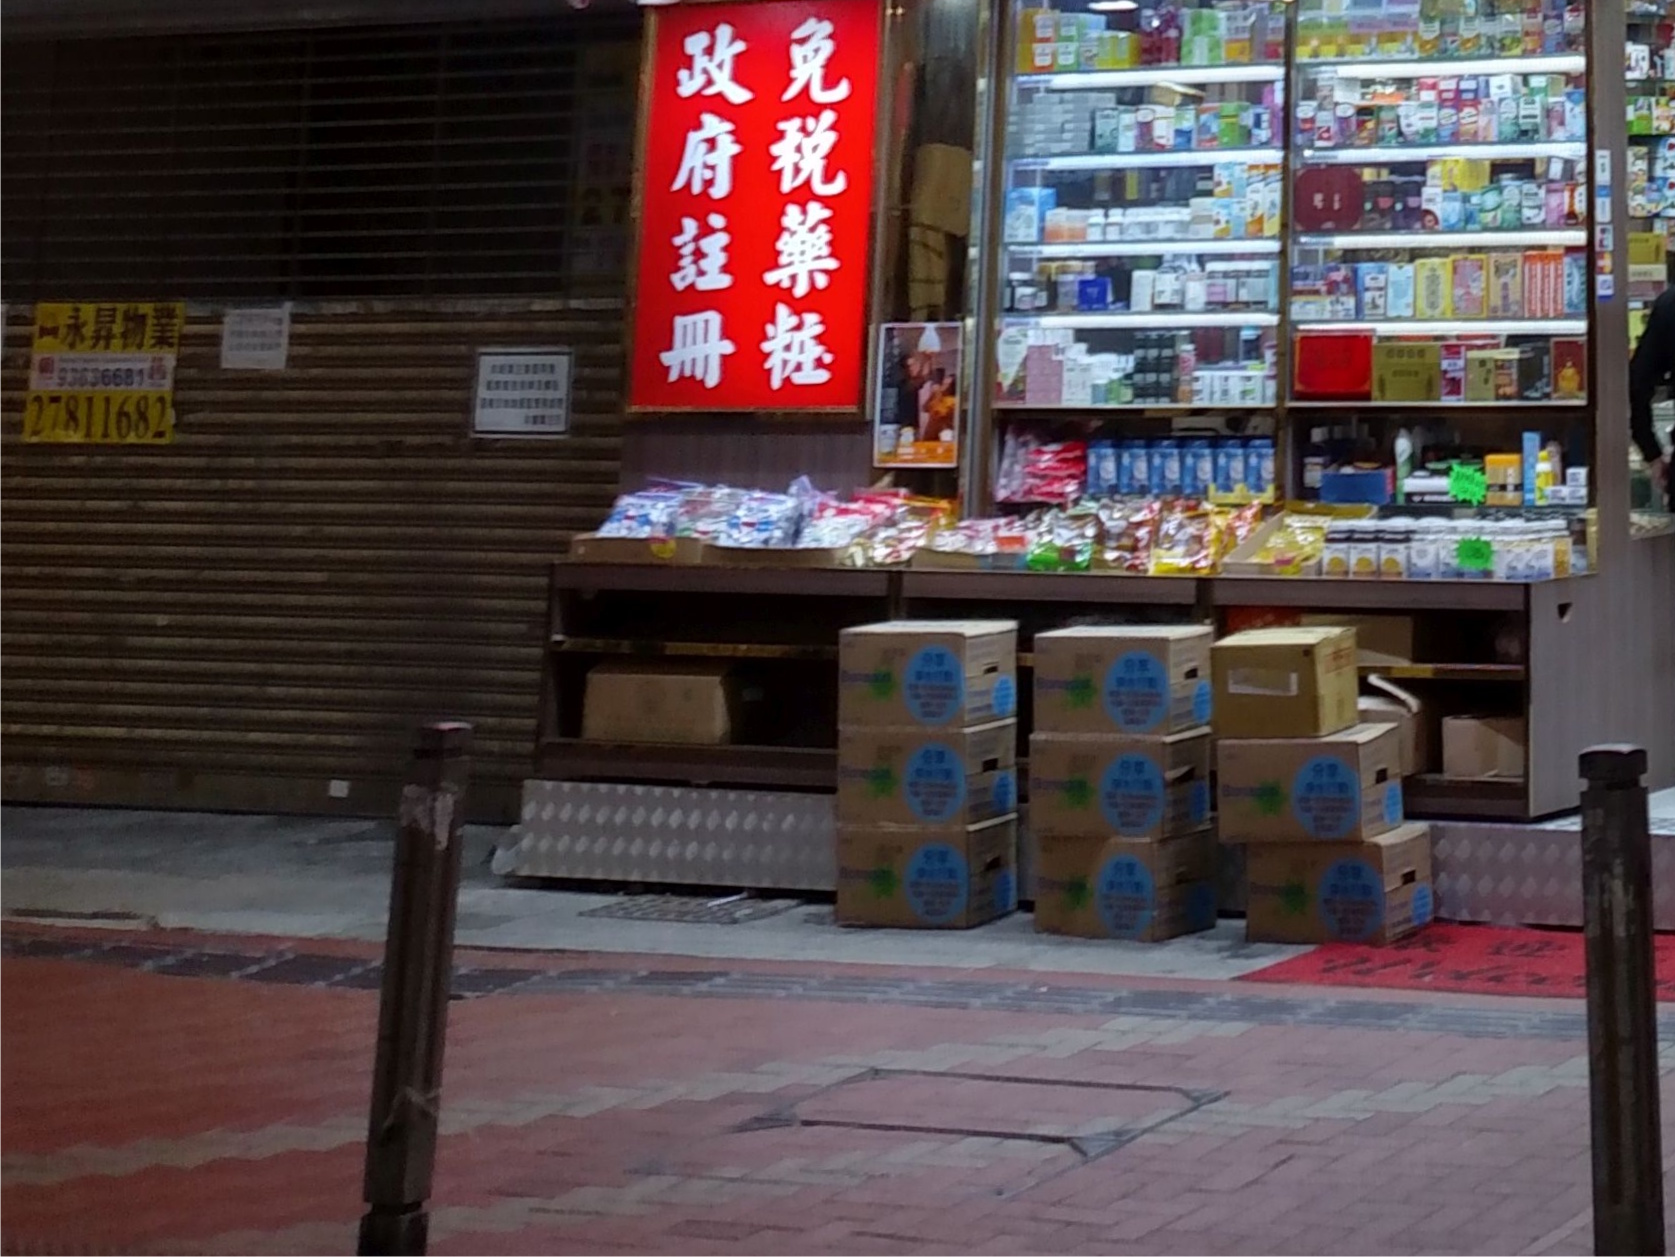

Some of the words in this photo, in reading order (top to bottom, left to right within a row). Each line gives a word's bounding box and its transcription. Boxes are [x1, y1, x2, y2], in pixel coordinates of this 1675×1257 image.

[659, 22, 755, 389] 政府註冊
[30, 395, 167, 439] 27811682
